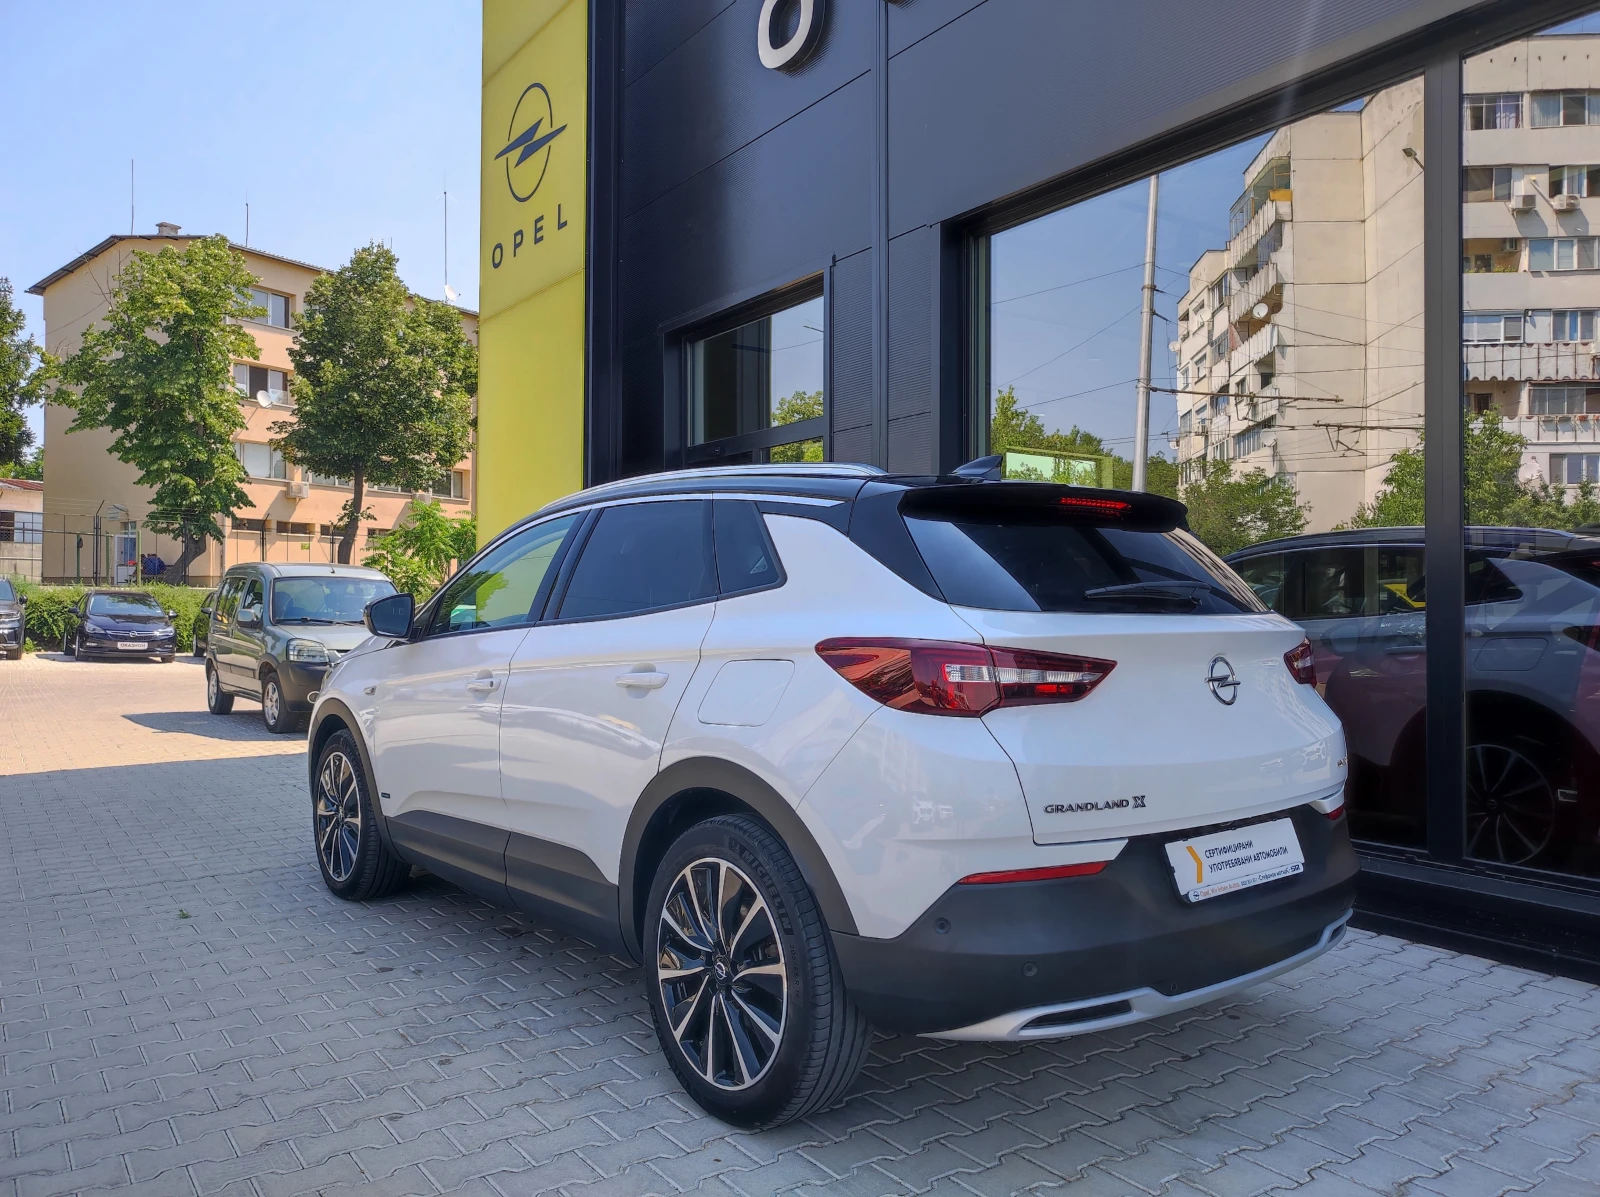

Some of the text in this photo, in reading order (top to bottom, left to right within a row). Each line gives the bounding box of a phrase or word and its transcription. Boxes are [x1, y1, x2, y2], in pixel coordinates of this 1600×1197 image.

[491, 203, 568, 269] OPEL
[1043, 795, 1147, 814] GRANDLAND X
[1204, 840, 1254, 858] СЕРТИФИЦИРАНИ
[1208, 846, 1289, 873] УПОТРЕБЯВАНИ АВТОМОБИЛИ
[741, 849, 792, 929] MICHELIN
